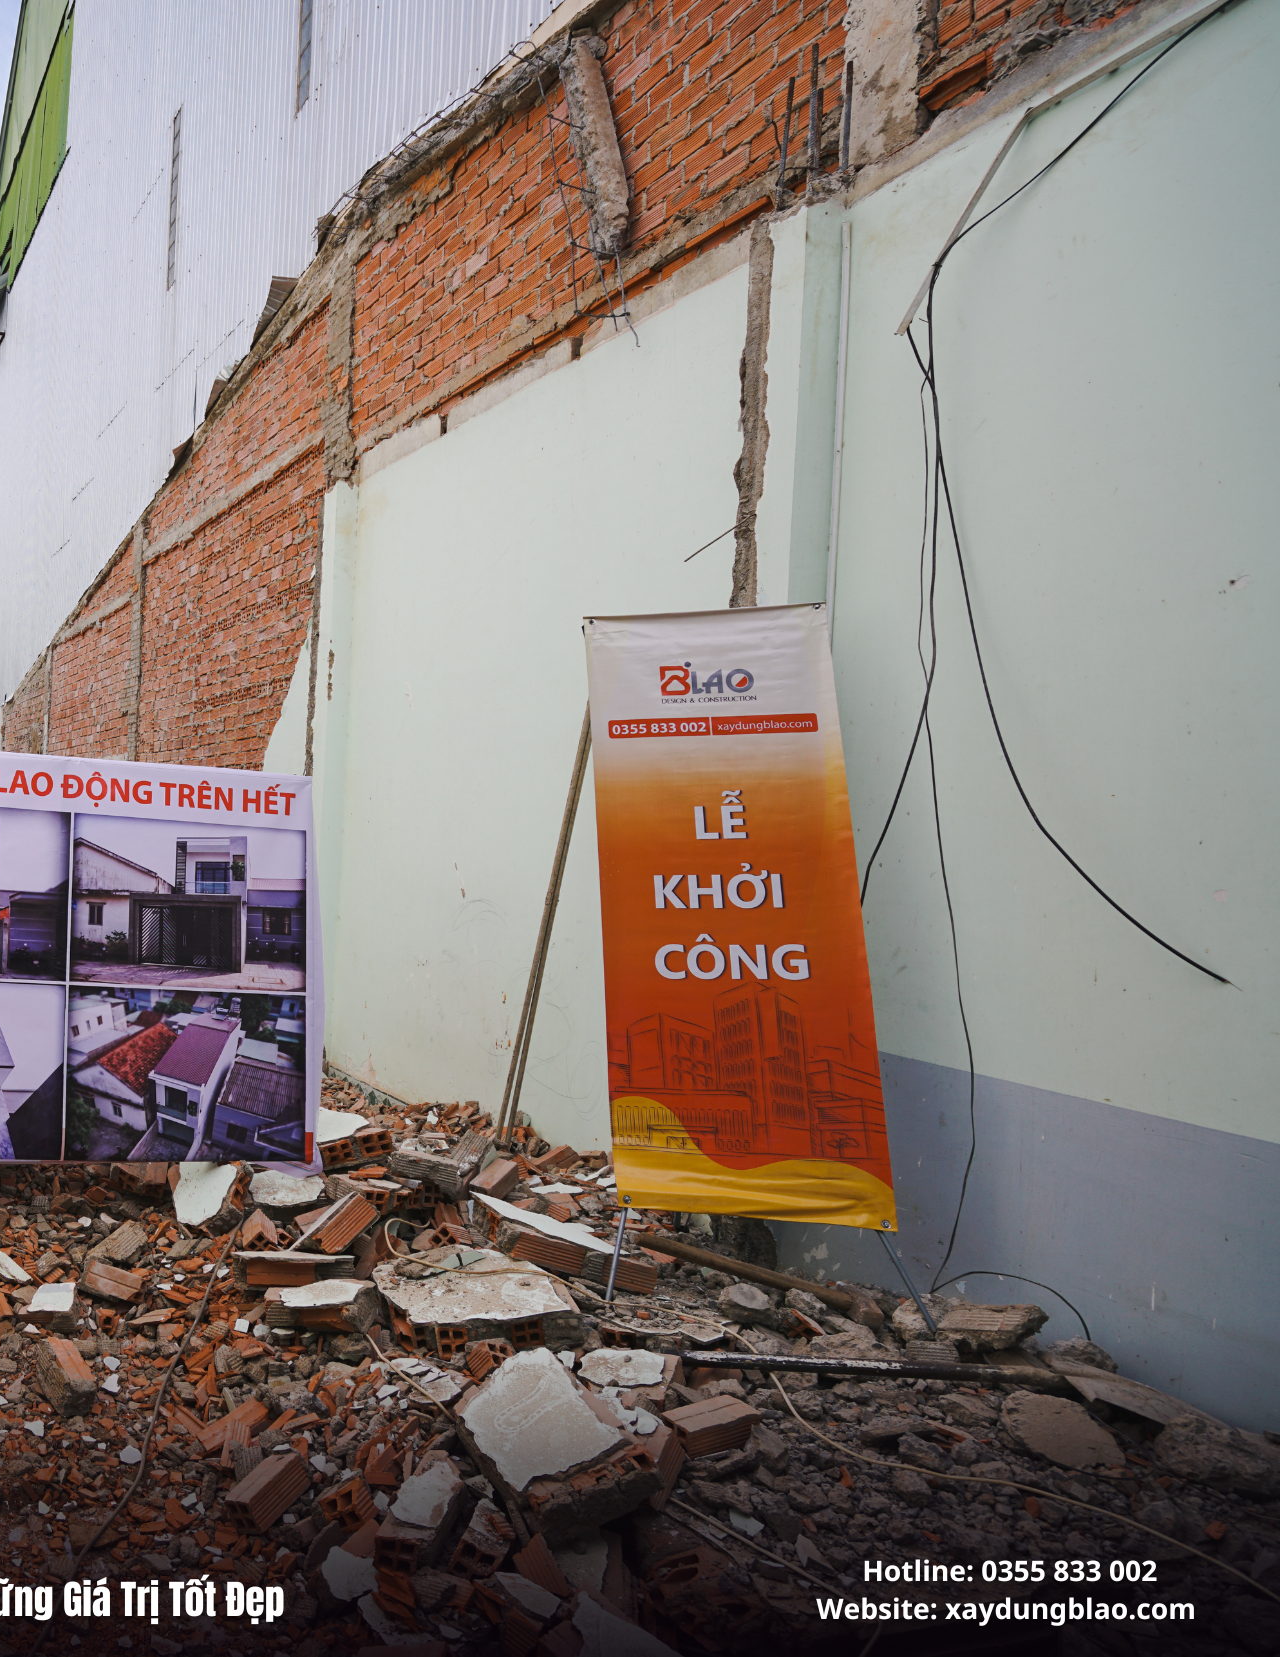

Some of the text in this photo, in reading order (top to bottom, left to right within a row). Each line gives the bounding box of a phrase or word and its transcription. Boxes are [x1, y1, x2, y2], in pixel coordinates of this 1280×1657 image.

[698, 695, 757, 703] CONSTRUCTION
[611, 718, 813, 735] 0355 833 002 xaydungblao.com
[60, 771, 153, 808] ĐỘNG
[159, 780, 233, 811] TRÊN
[242, 784, 296, 816] HẾT
[694, 789, 748, 840] LỄ
[653, 863, 785, 909] KHỞI
[654, 933, 811, 981] CÔNG
